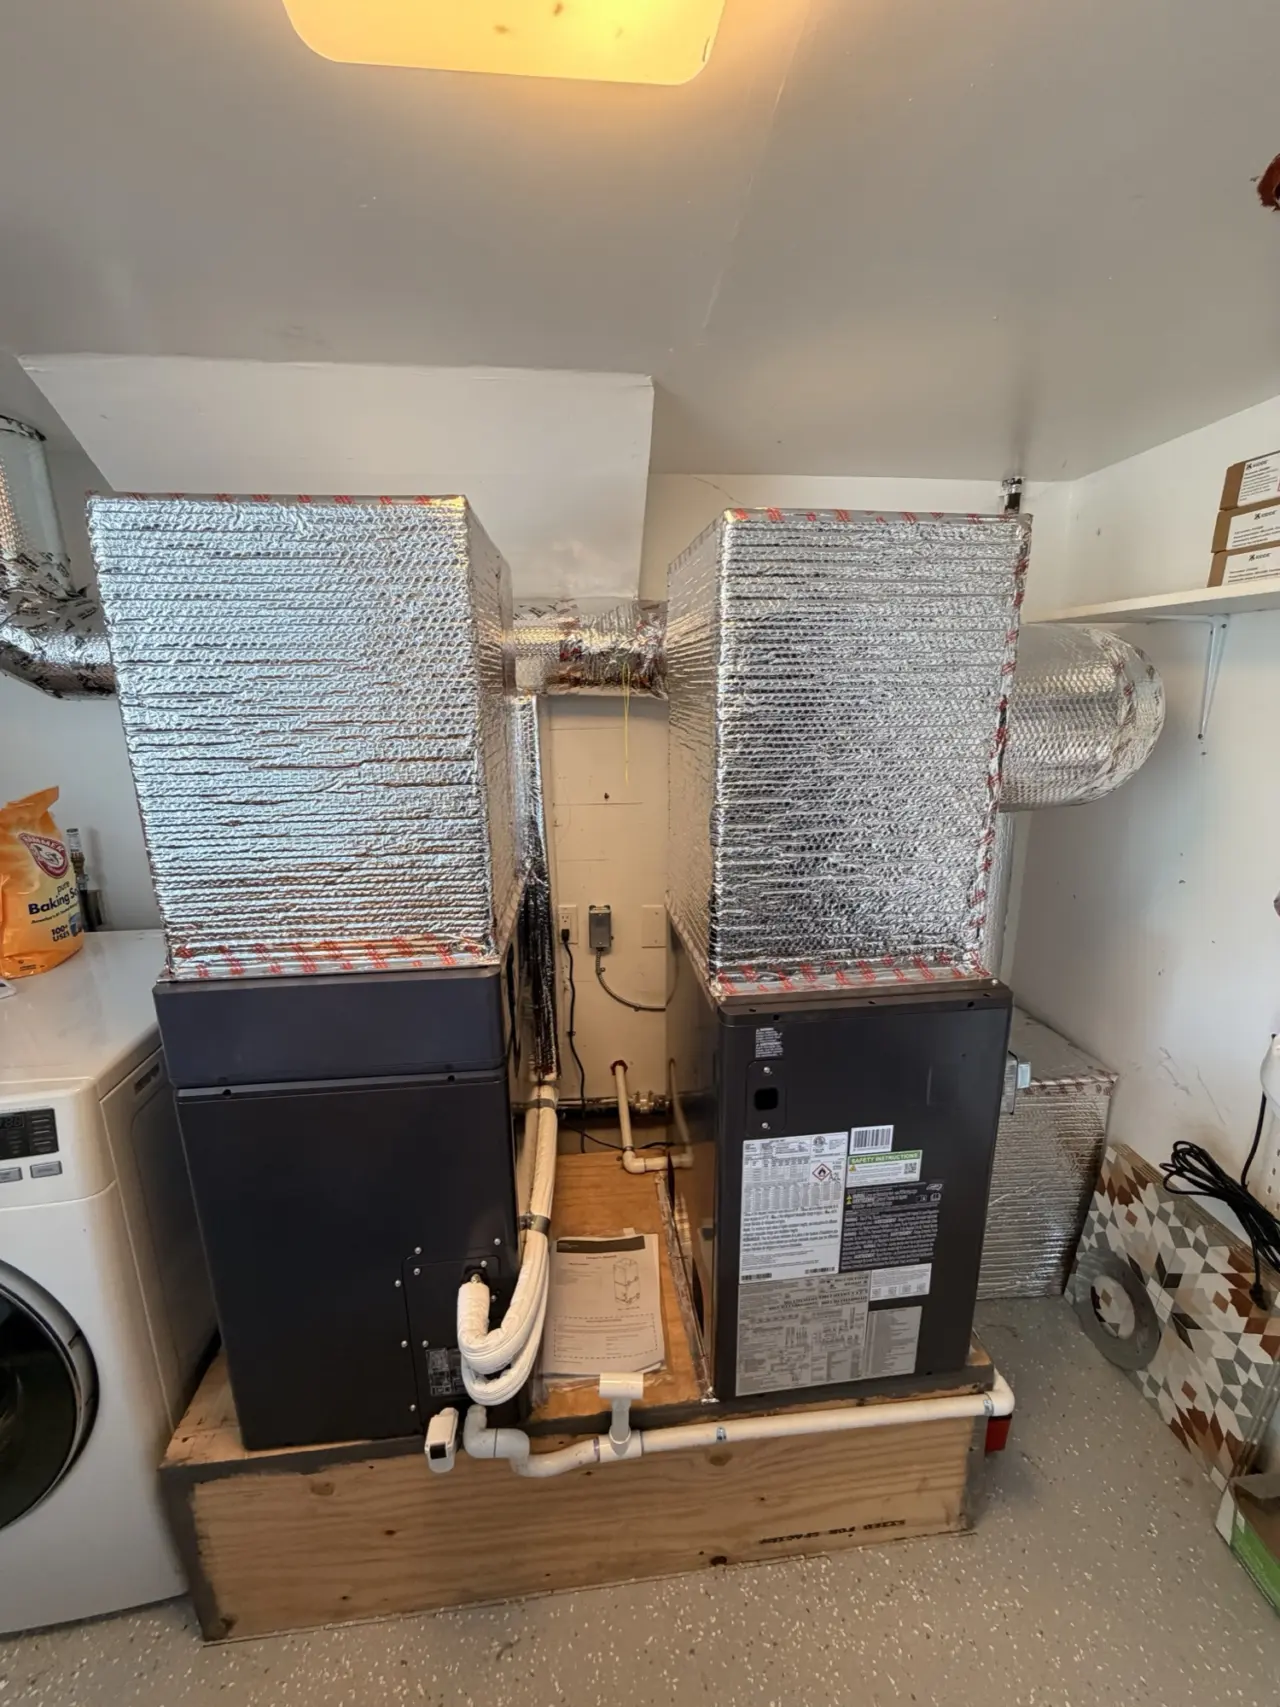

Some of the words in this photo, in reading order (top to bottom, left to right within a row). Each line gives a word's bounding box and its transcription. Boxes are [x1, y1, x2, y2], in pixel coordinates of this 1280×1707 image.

[28, 893, 70, 915] Baking
[52, 930, 70, 942] USES
[875, 1153, 918, 1162] INSTRUCTIONS
[828, 1526, 856, 1535] FOR
